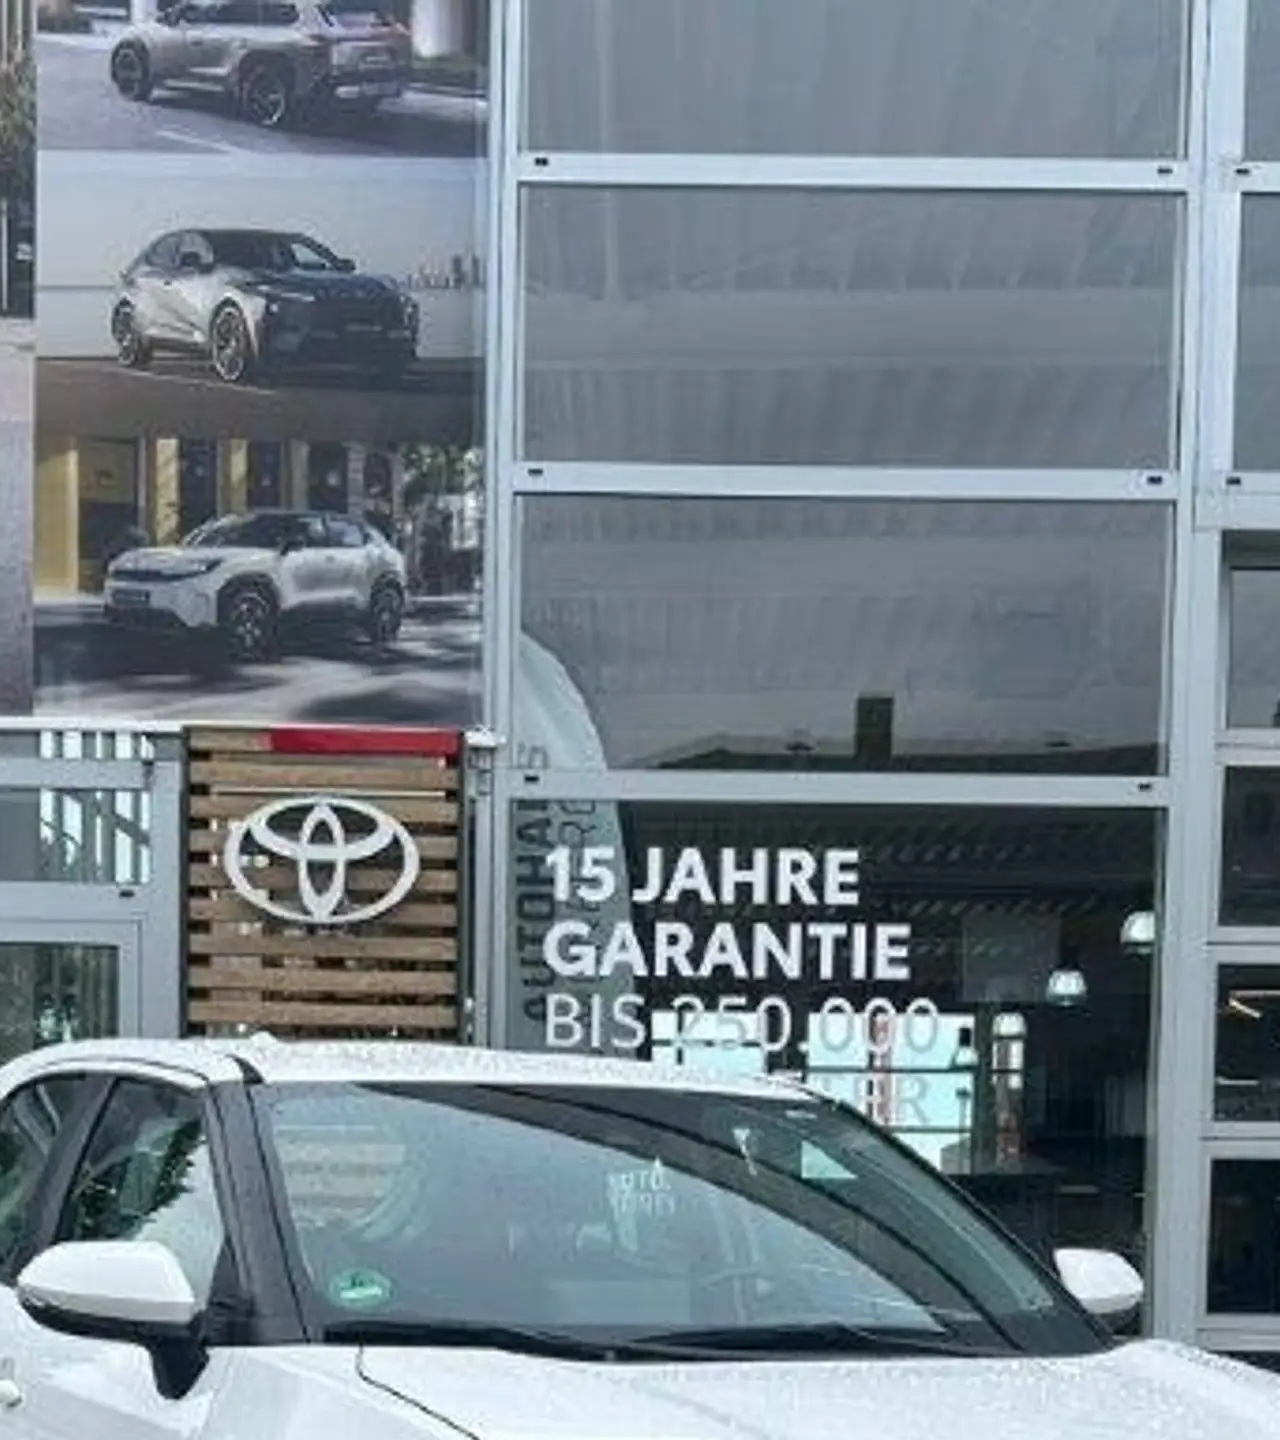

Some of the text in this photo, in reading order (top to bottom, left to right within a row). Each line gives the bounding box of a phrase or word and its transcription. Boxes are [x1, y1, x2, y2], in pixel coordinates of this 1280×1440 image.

[545, 846, 860, 906] 15 JAHRE
[542, 920, 912, 980] GARANTIE
[546, 993, 939, 1054] BIS 250.000
